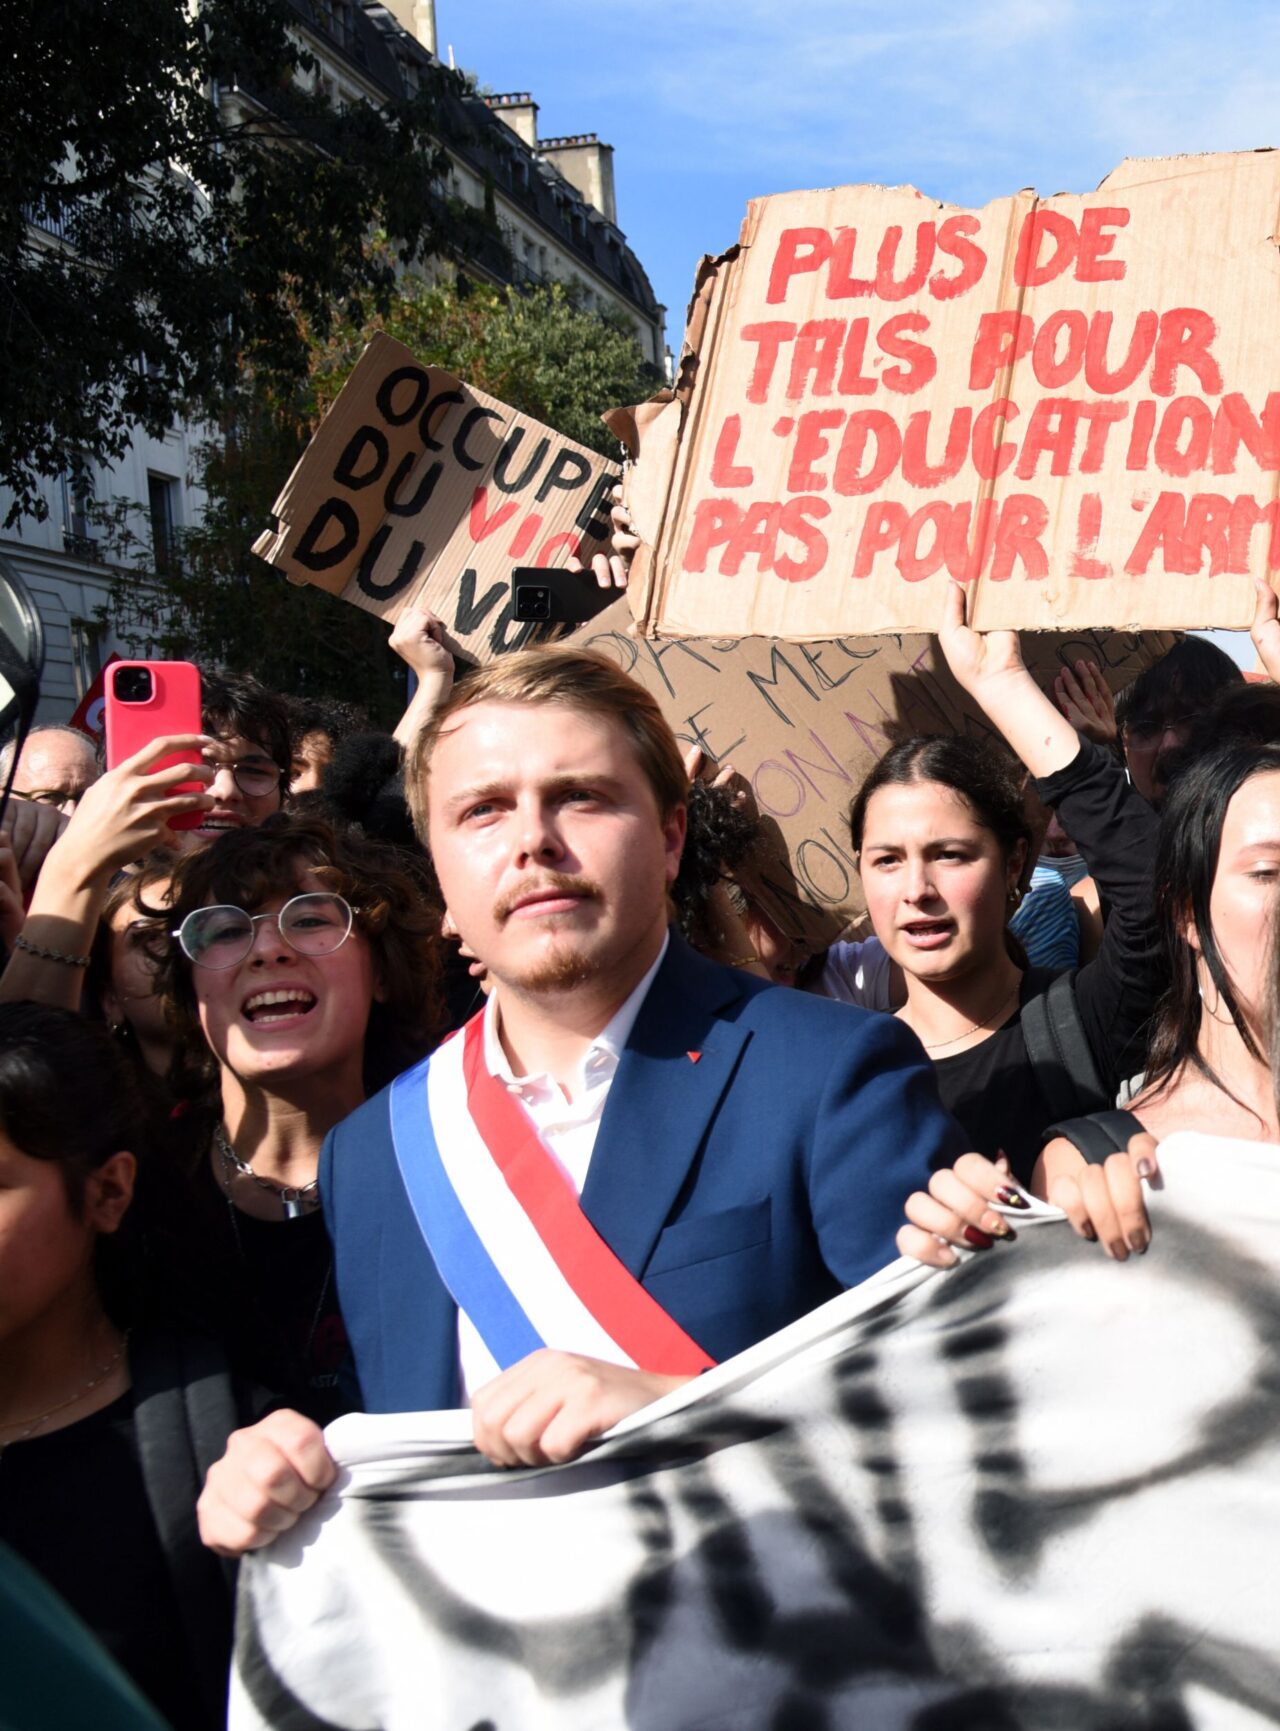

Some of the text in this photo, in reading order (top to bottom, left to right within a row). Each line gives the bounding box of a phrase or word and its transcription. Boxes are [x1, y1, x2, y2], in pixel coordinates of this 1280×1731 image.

[766, 206, 1130, 304] PLUS DE
[740, 307, 1223, 405] TALS POUR
[333, 425, 444, 517] DU
[376, 366, 622, 541] OCCUPE
[293, 498, 425, 600] DU
[682, 496, 832, 582] PAS
[852, 498, 1050, 581] POUR
